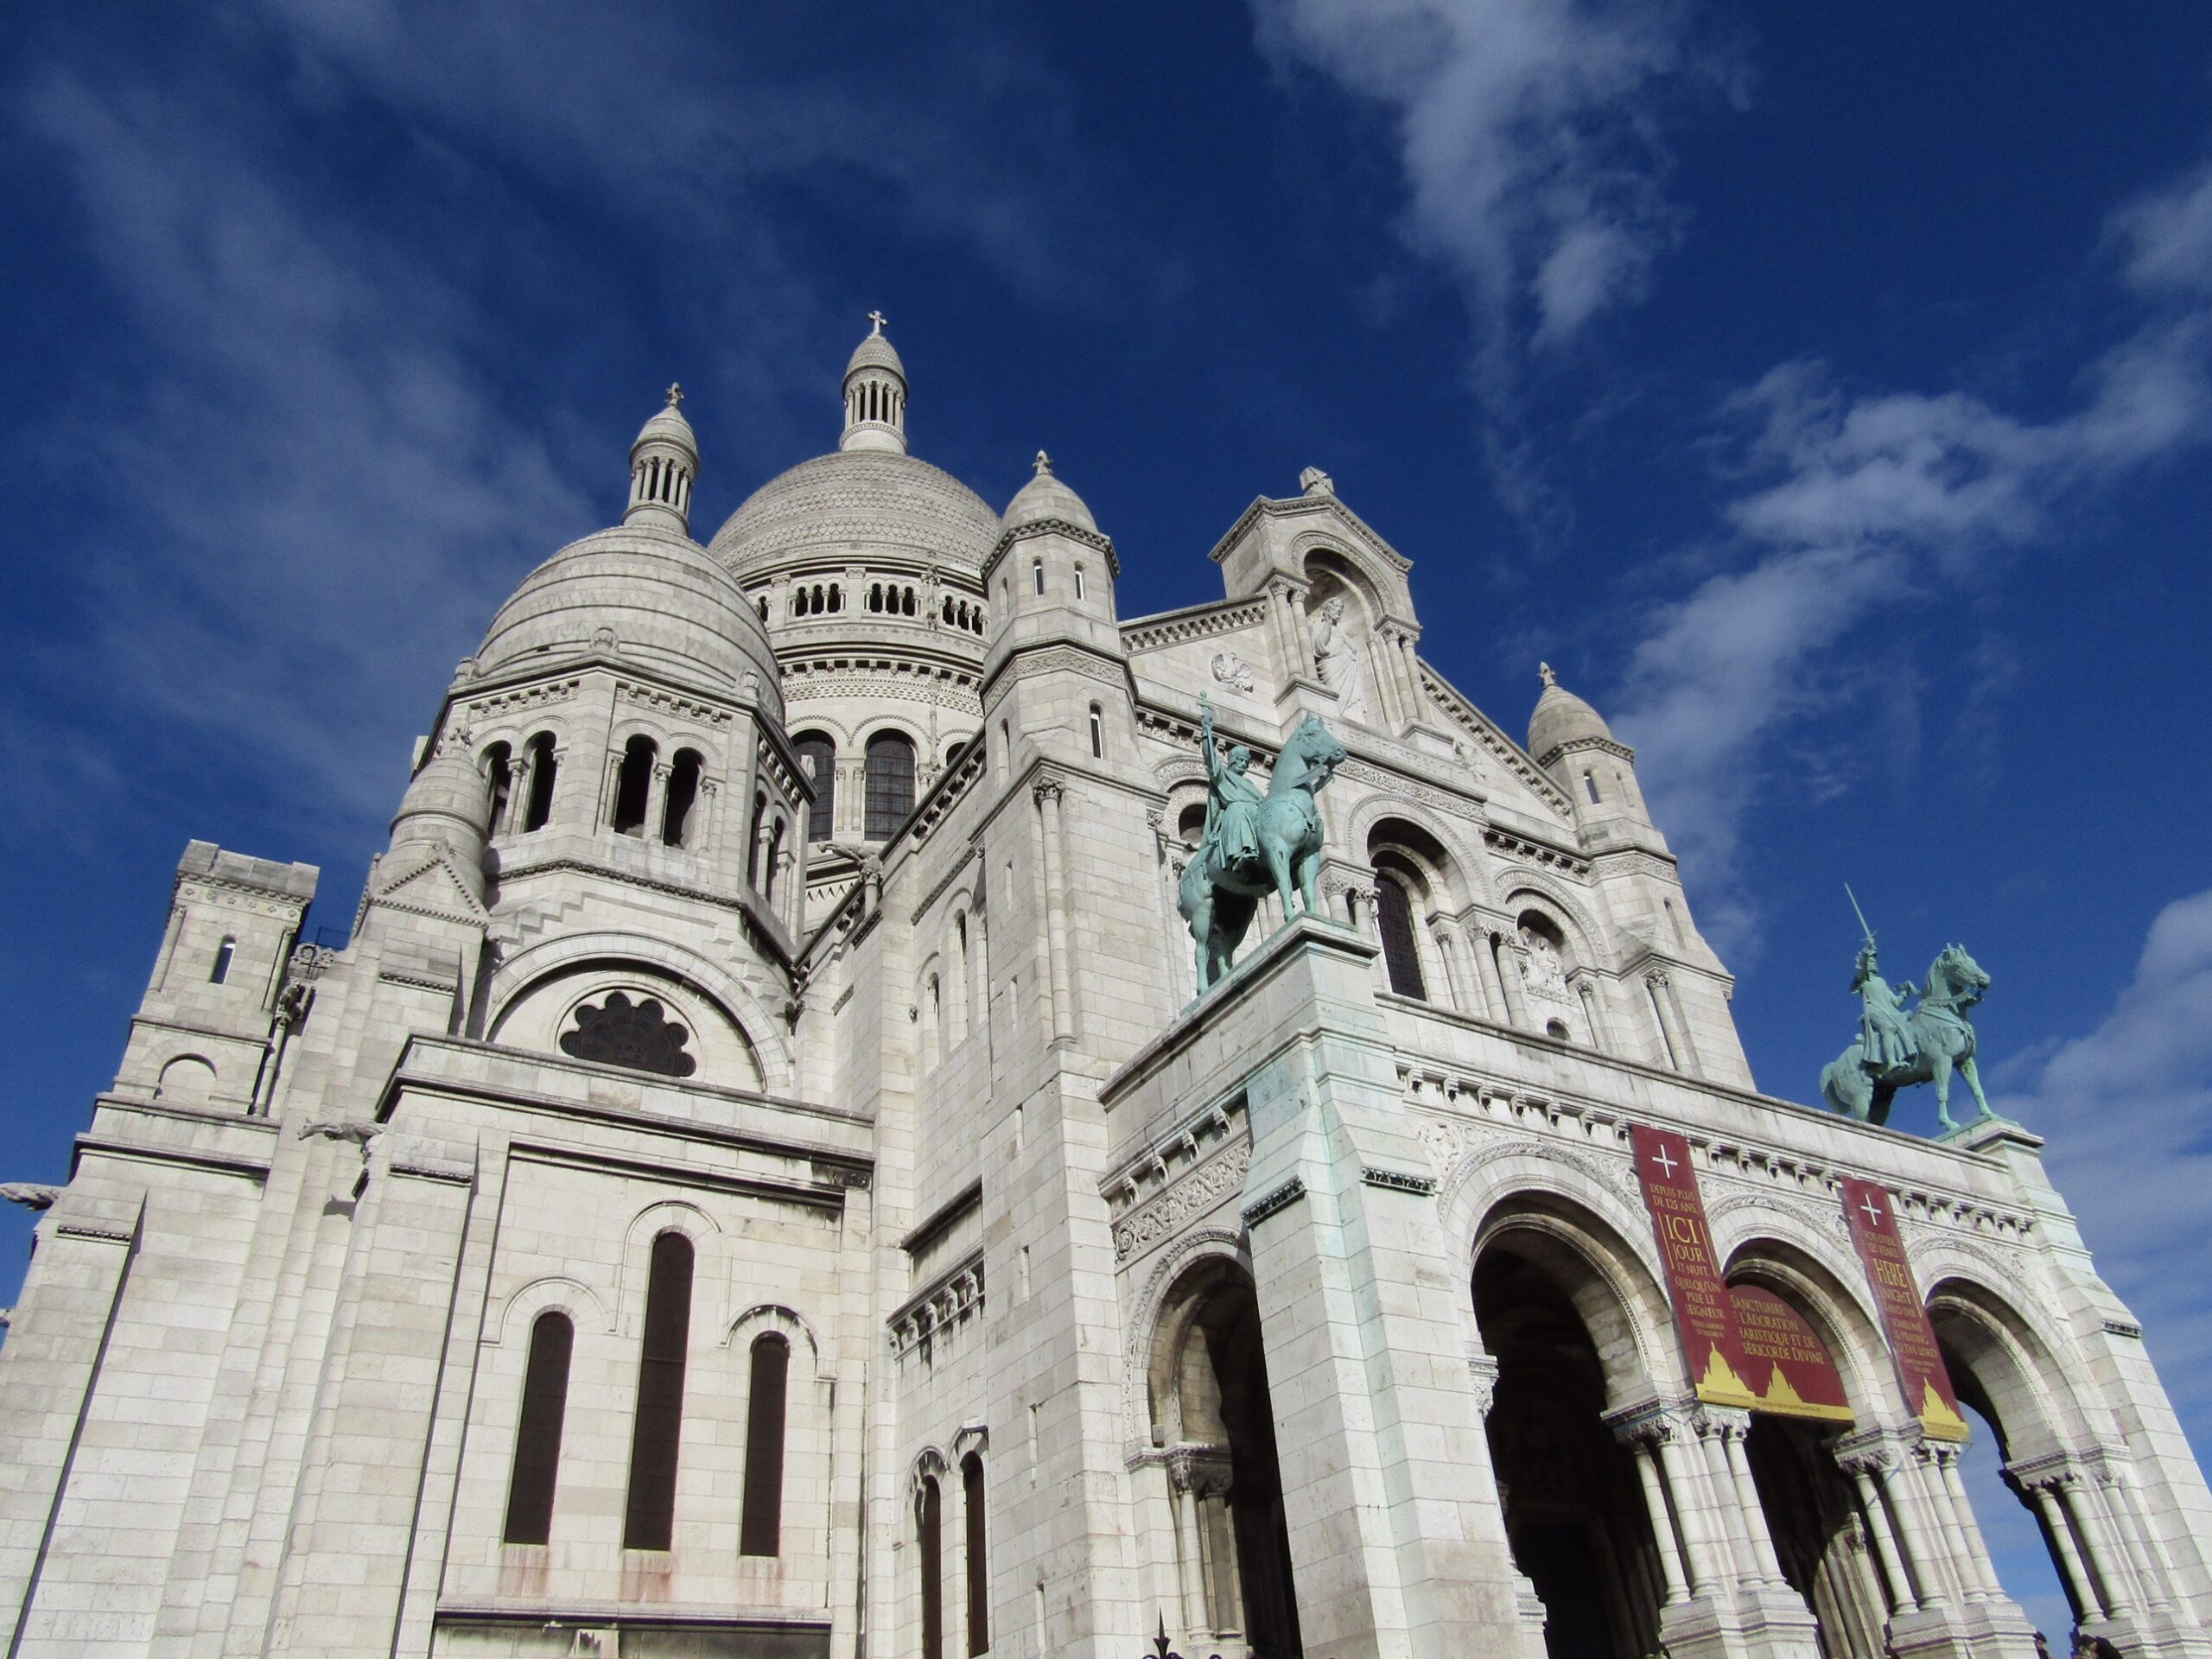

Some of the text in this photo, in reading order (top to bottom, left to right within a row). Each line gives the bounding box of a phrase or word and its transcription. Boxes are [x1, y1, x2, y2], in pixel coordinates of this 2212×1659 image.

[1649, 1183, 1694, 1201] DEPUIS PLUS
[1652, 1194, 1664, 1207] DE
[1666, 1198, 1678, 1210] 125
[1664, 1214, 1700, 1244] ICI
[1672, 1243, 1707, 1262] JOUR
[1676, 1262, 1685, 1273] ET
[1873, 1257, 1908, 1287] HERE
[1686, 1291, 1715, 1305] PRIE LE
[1730, 1294, 1786, 1316] SANCTUAIRE
[1881, 1287, 1911, 1305] NIGHT
[1739, 1311, 1799, 1332] L'ADORATION
[1790, 1333, 1802, 1347] ET
[1802, 1335, 1815, 1348] DE
